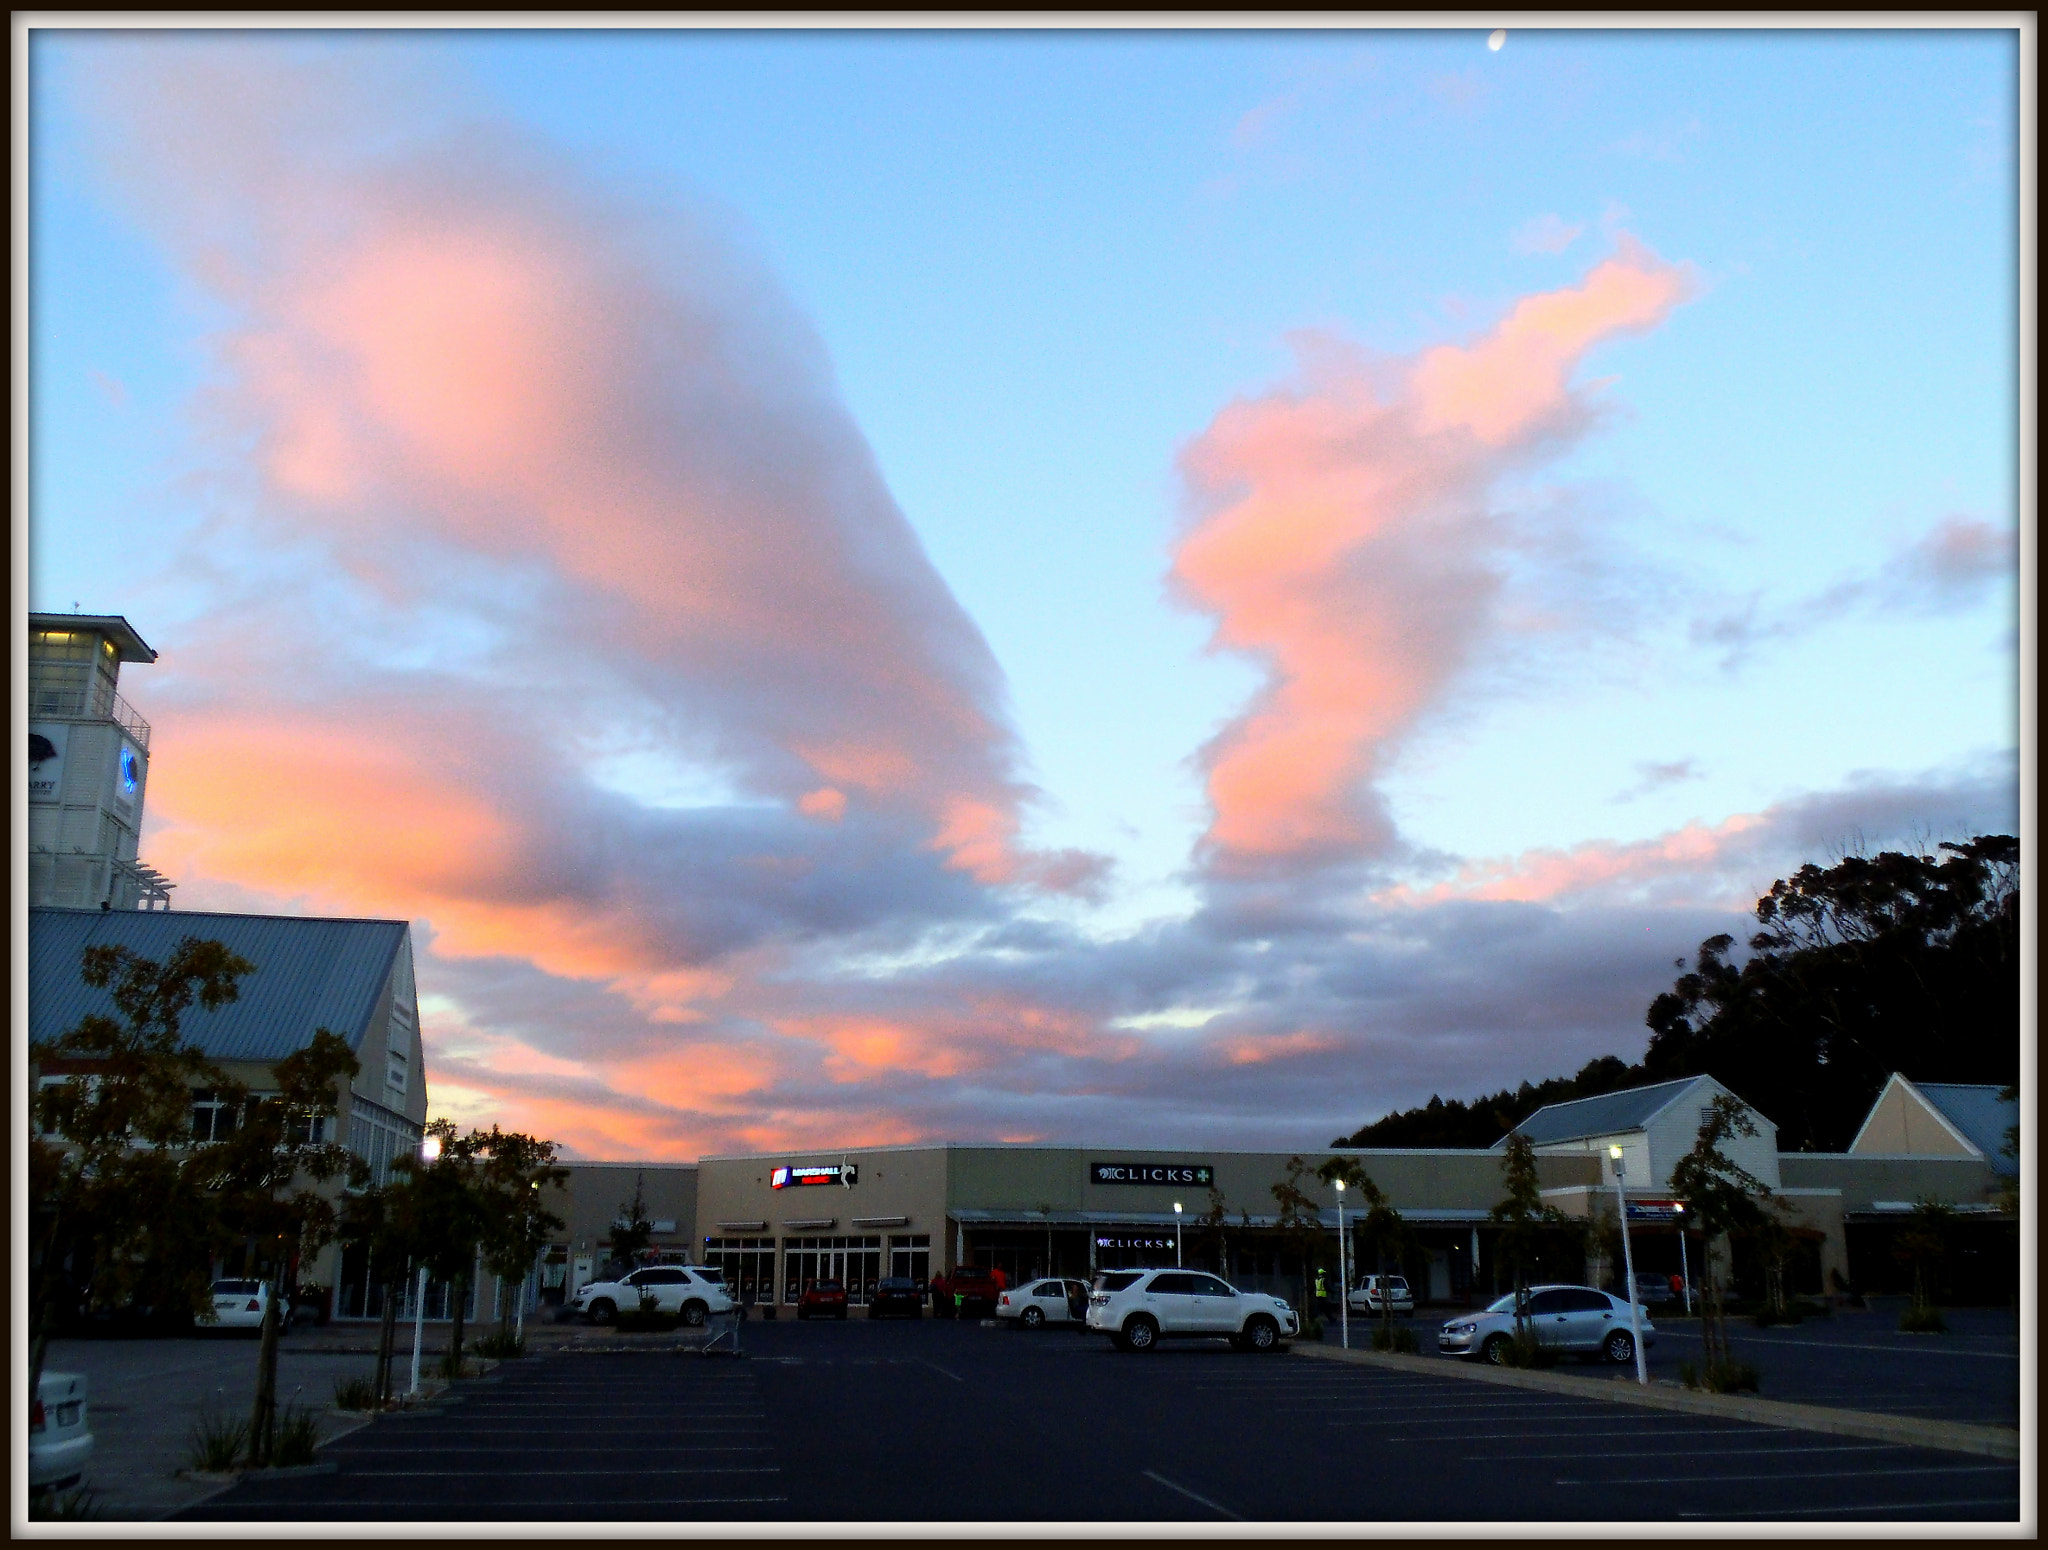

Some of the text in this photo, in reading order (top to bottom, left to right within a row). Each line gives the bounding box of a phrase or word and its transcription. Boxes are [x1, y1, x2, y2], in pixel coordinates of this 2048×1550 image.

[792, 1168, 840, 1176] MARSHALL
[1114, 1168, 1193, 1182] CLICKS
[802, 1176, 830, 1184] MUSIC
[1107, 1239, 1164, 1248] CLICKS
